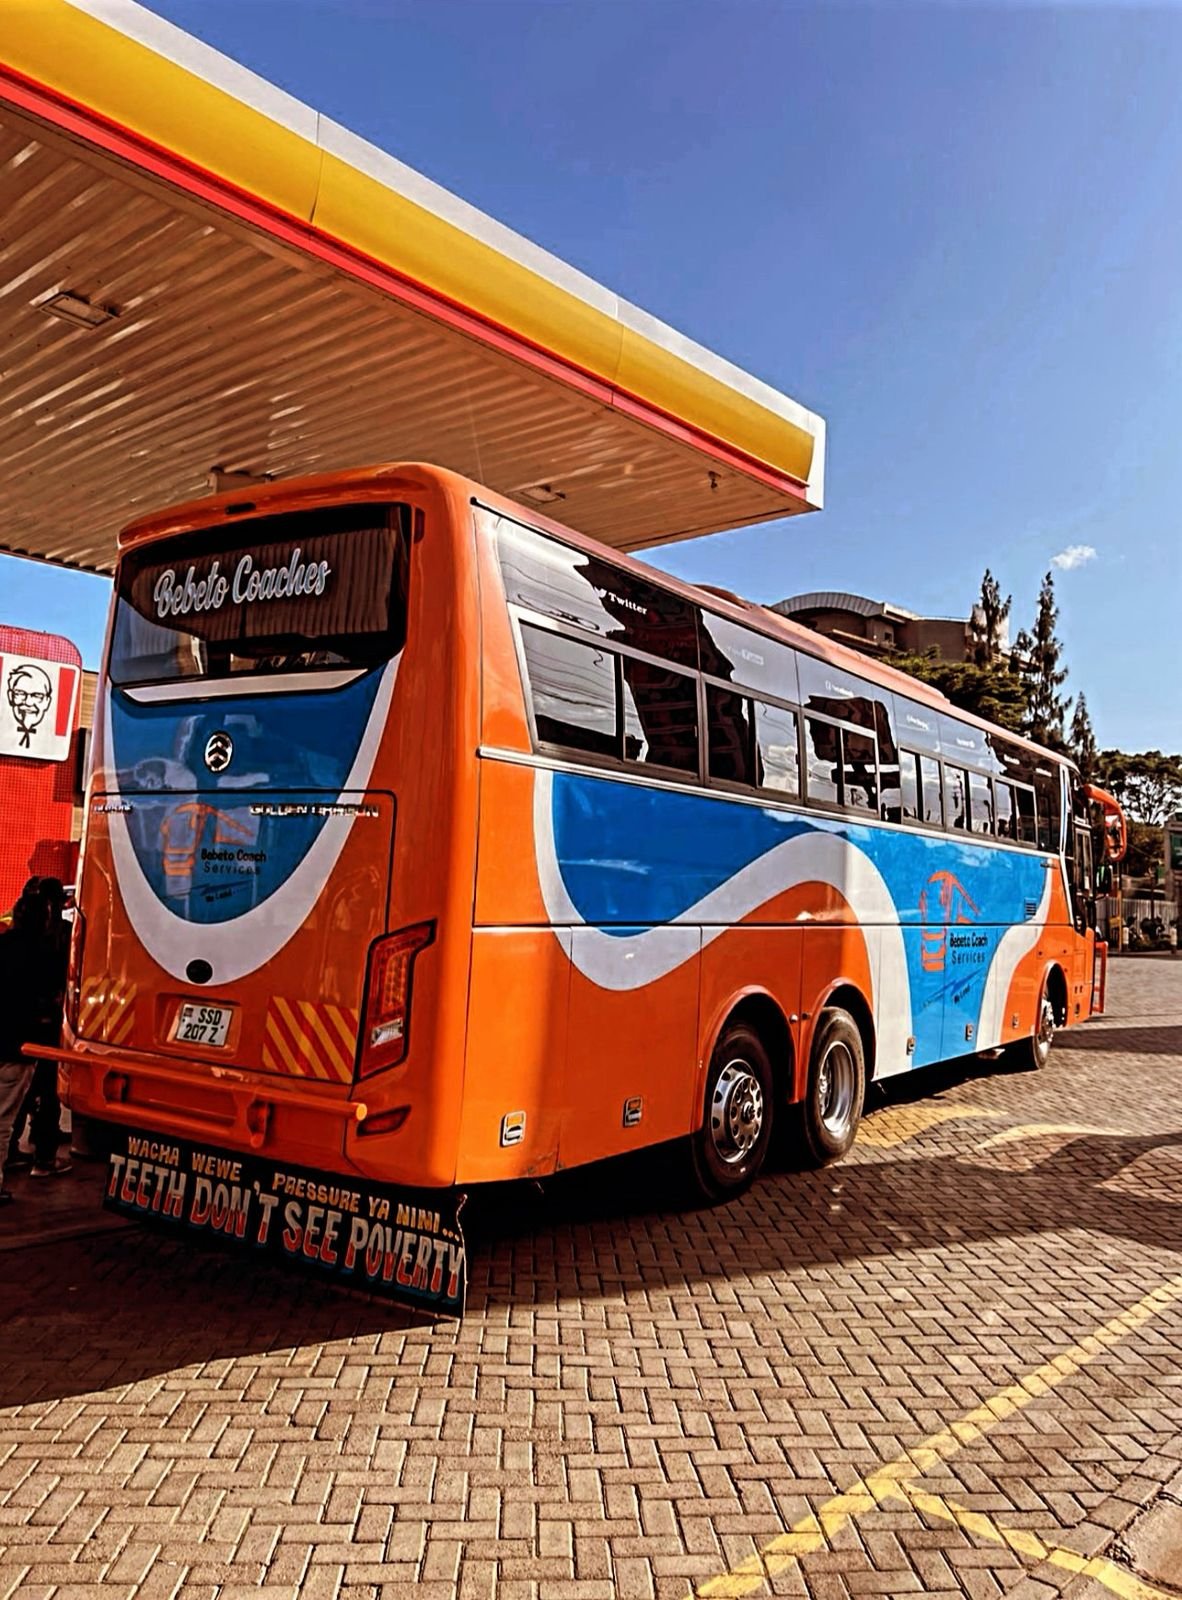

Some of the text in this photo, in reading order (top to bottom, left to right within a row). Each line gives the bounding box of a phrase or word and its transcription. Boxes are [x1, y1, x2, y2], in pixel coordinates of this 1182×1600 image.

[154, 547, 332, 618] Bebeto Coaches
[608, 591, 648, 615] Twitter
[203, 861, 262, 875] Services
[951, 950, 985, 965] Services
[198, 1007, 223, 1026] SSD
[183, 1022, 219, 1043] 207 Z
[128, 1136, 180, 1166] WACHA
[191, 1151, 243, 1182] WEWE
[271, 1172, 361, 1213] PRESSURE
[368, 1195, 391, 1220] YA
[108, 1153, 465, 1299] TEETH DON'T SEE POVERTY
